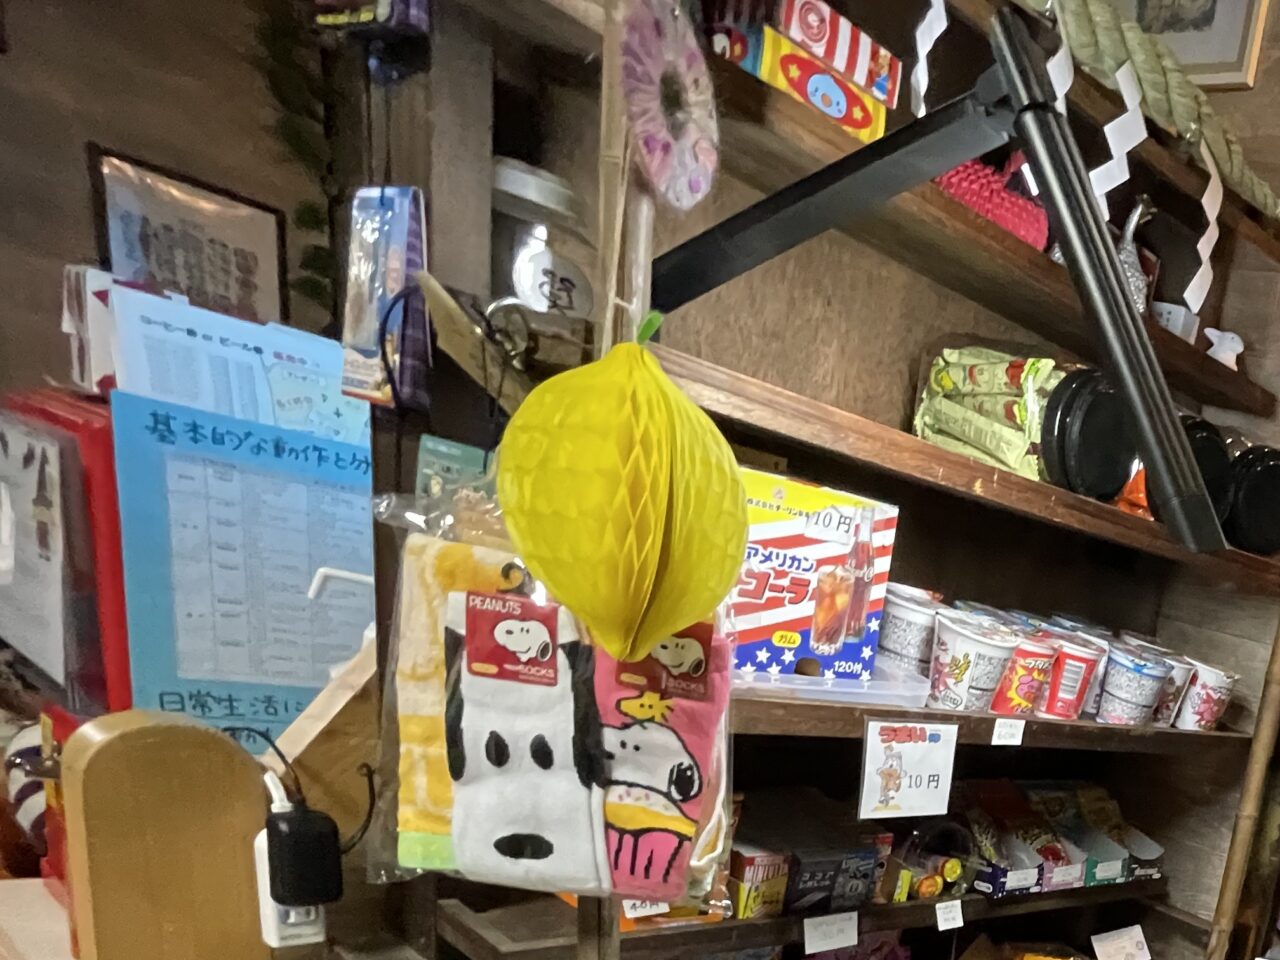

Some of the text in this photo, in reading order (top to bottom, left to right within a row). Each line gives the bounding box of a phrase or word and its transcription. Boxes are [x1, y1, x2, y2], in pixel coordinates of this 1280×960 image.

[747, 546, 814, 573] アメリカン
[737, 571, 811, 605] コーラ
[468, 597, 522, 616] PEANUTS
[907, 774, 941, 789] 10円
